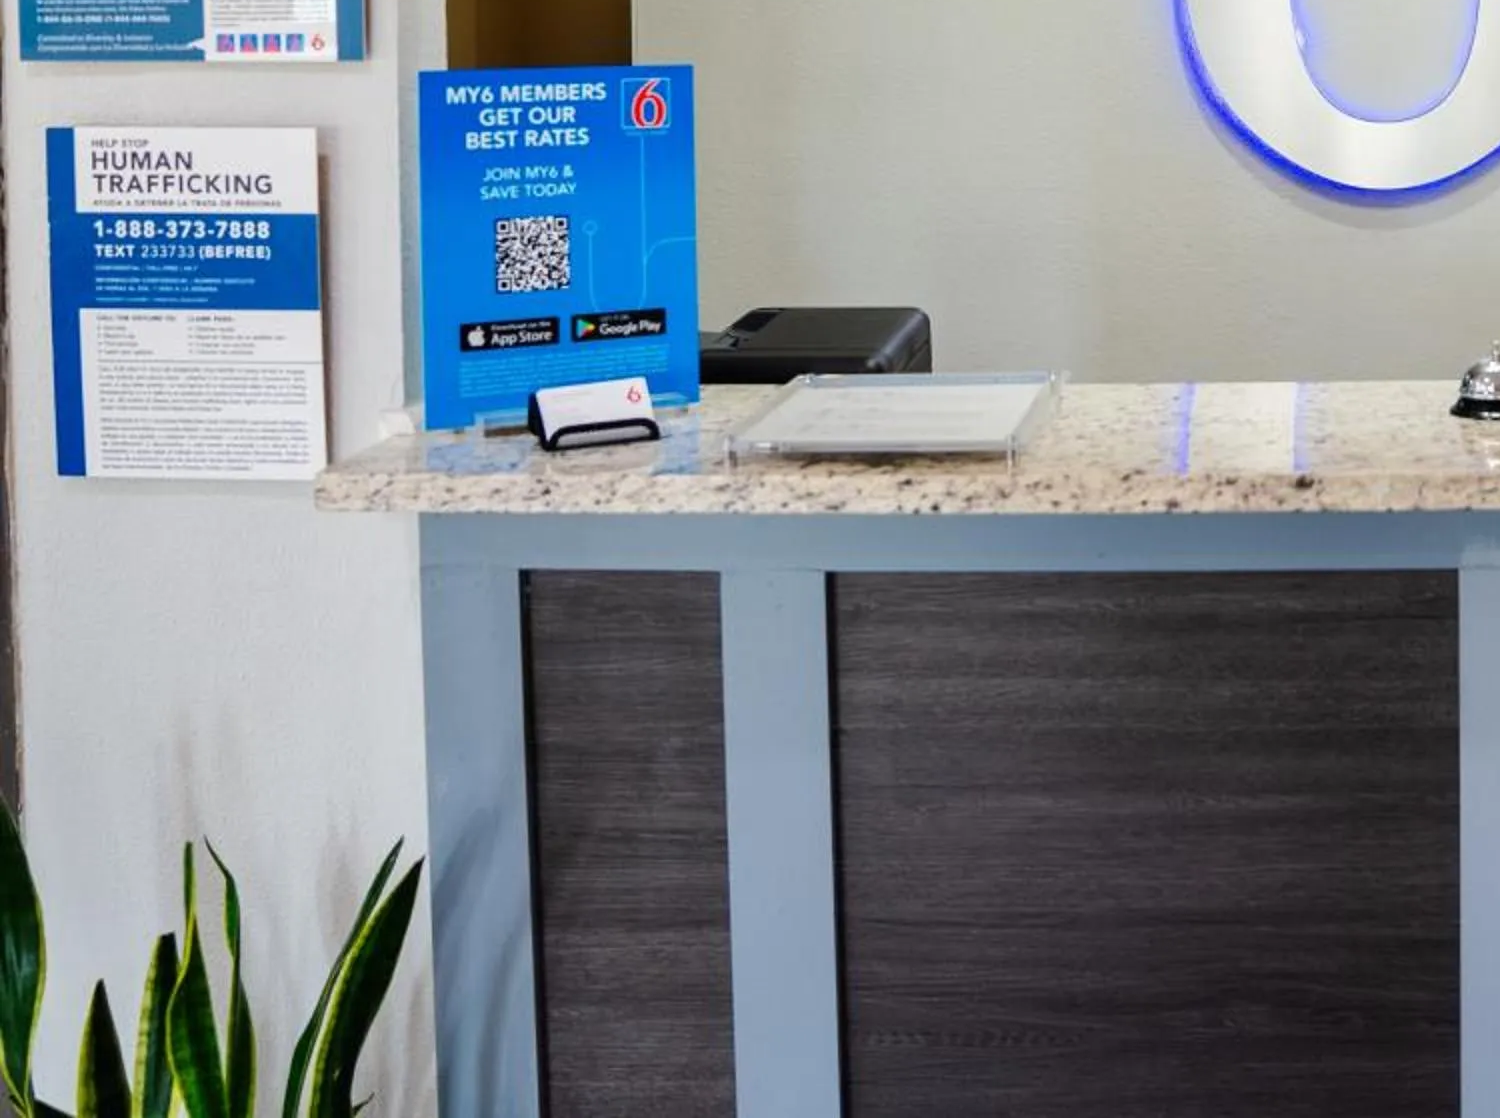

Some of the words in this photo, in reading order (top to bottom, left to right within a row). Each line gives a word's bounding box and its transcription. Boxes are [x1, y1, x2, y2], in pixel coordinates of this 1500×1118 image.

[312, 34, 325, 51] 6
[446, 86, 494, 104] MY6
[499, 82, 607, 103] MEMBERS
[631, 78, 667, 129] 6
[479, 108, 523, 126] GET
[528, 107, 576, 125] OUR
[91, 139, 119, 148] HELP
[121, 139, 150, 148] STOP
[465, 131, 519, 150] BEST
[524, 128, 590, 148] RATES
[91, 151, 193, 171] HUMAN
[483, 167, 521, 182] JOIN
[525, 166, 558, 180] MY6
[563, 165, 574, 178] &
[93, 174, 273, 194] TRAFFICKING
[480, 185, 520, 200] SAVE
[525, 182, 577, 198] TODAY
[93, 220, 270, 240] 1-888-373-7888
[94, 244, 135, 259] TEXT
[140, 245, 196, 259] 233733
[199, 245, 272, 261] (BEFREE)
[599, 321, 637, 335] Google
[639, 319, 662, 333] Play
[491, 332, 517, 348] App
[519, 328, 553, 343] Store
[627, 385, 642, 403] 6
